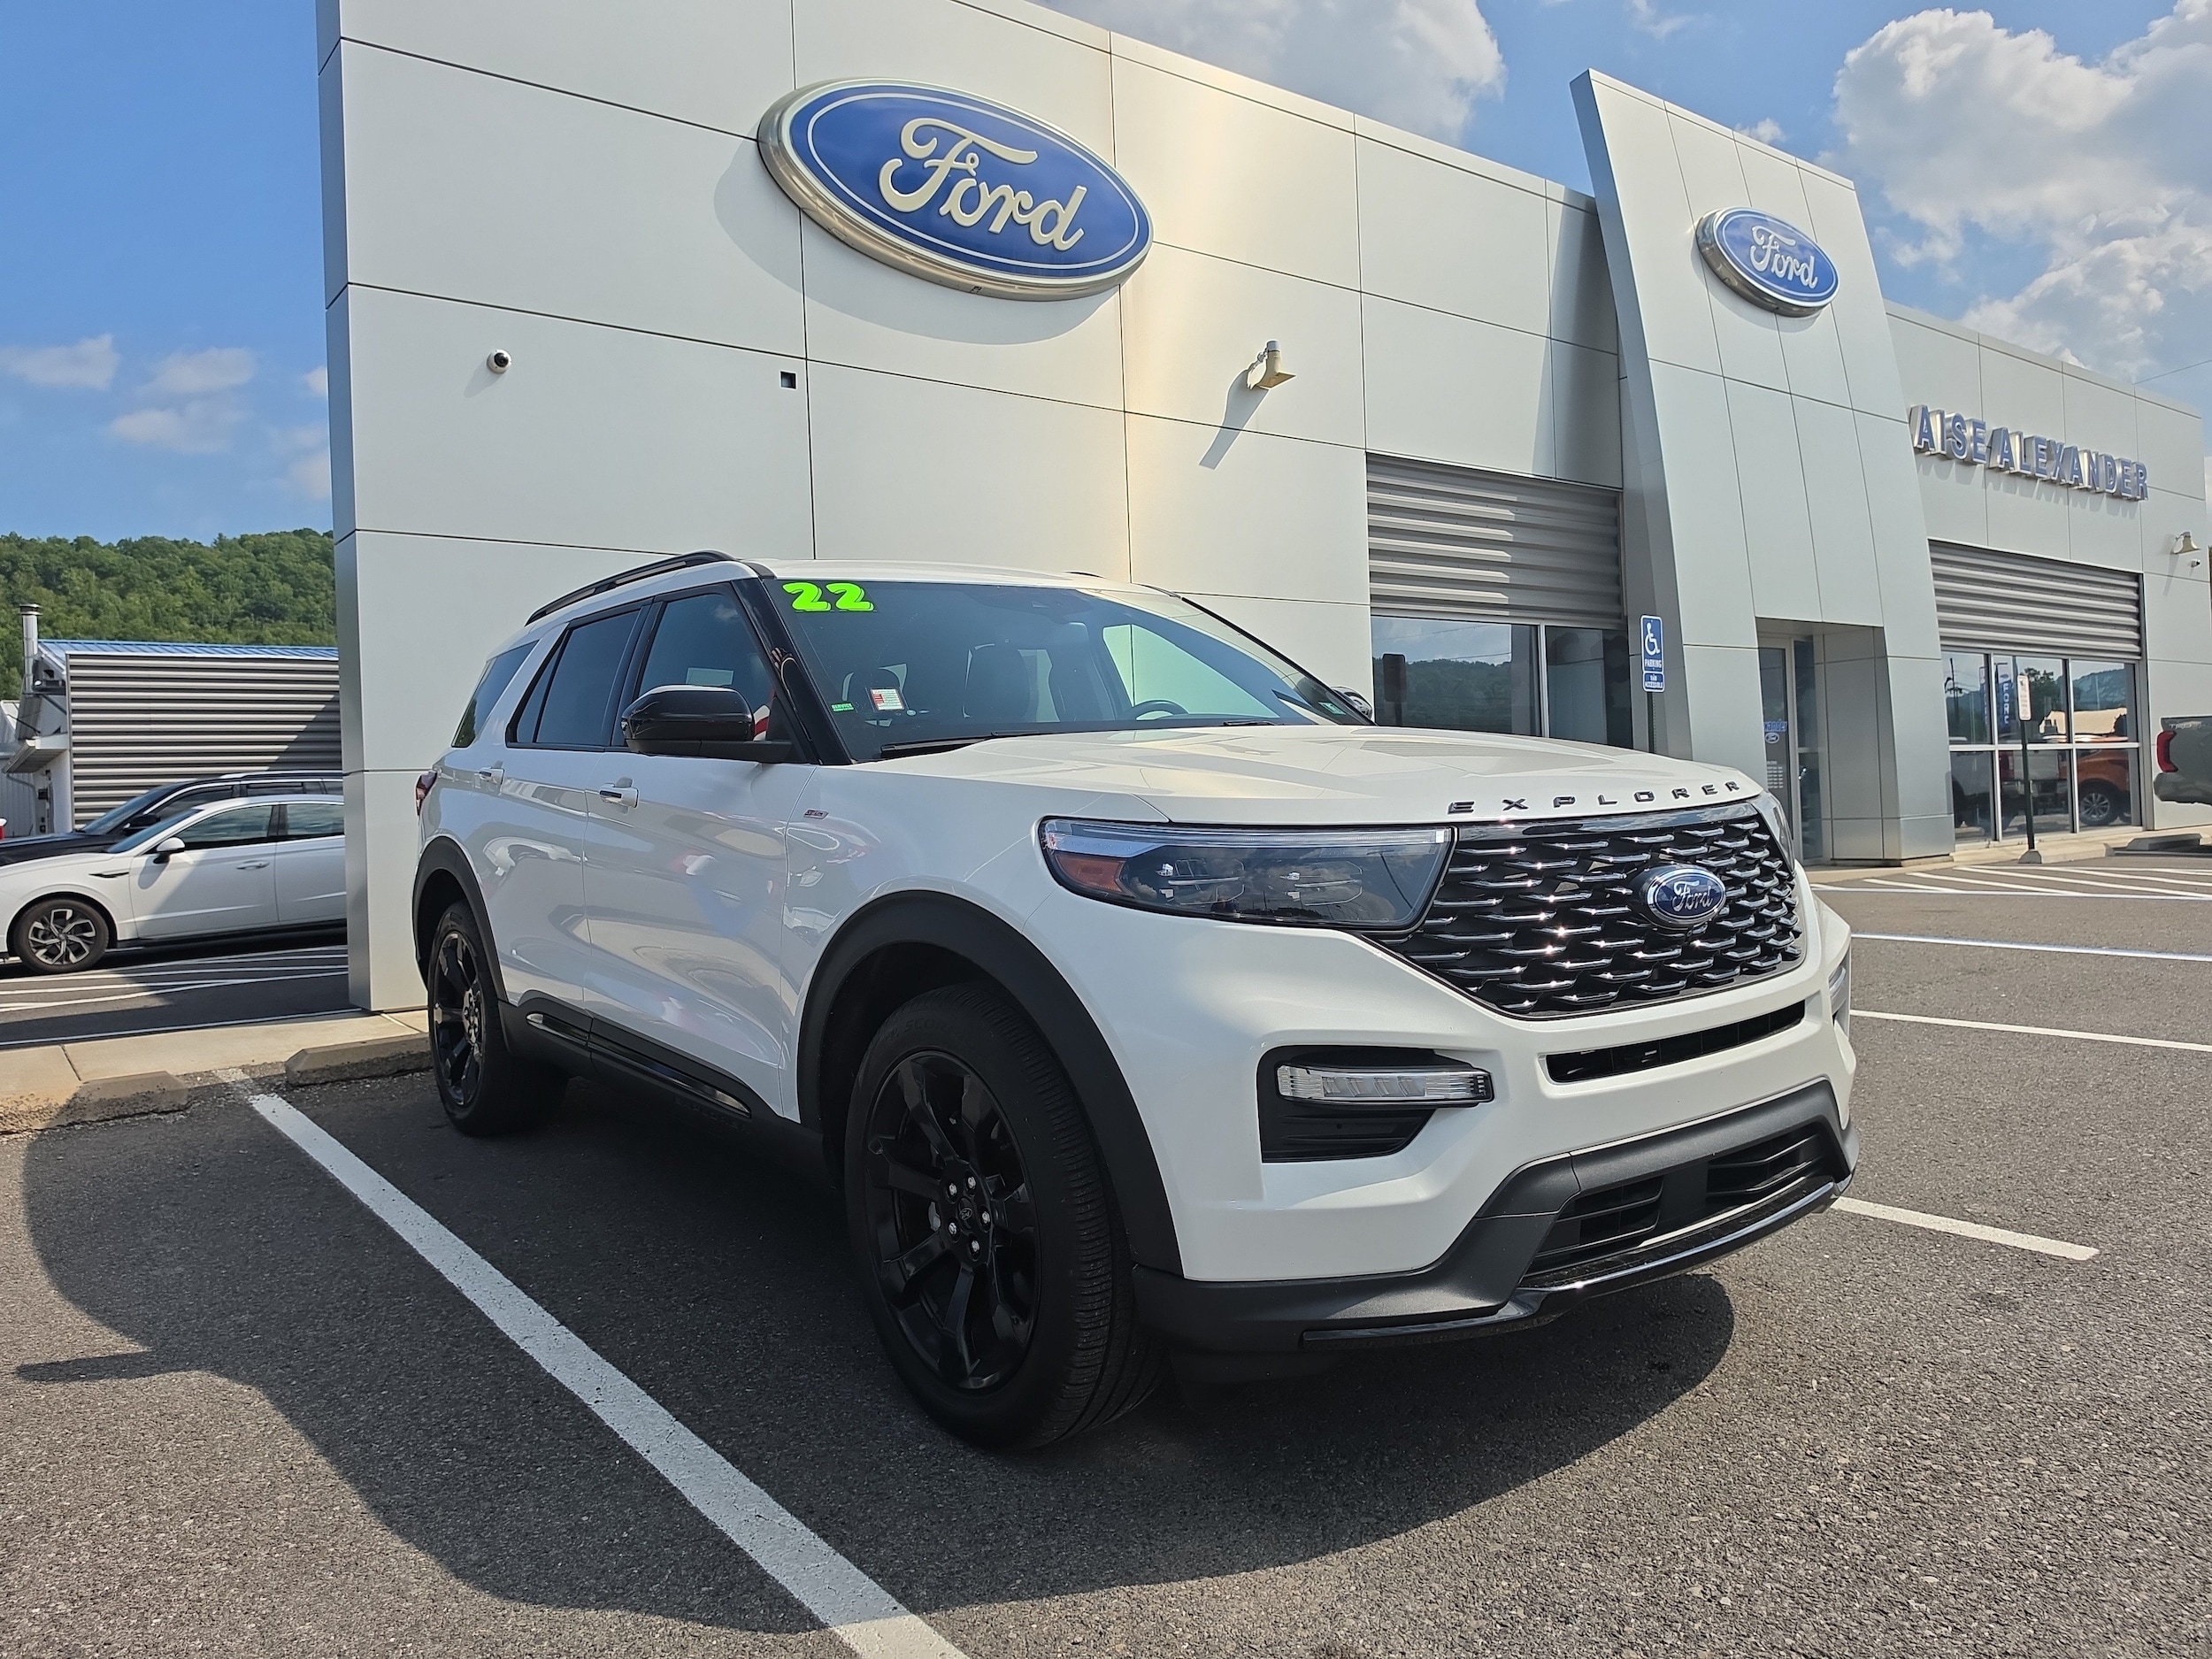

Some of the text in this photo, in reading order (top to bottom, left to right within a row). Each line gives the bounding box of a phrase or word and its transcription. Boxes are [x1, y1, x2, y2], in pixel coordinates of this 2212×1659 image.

[879, 117, 1088, 250] Ford
[1749, 226, 1818, 289] Ford
[1909, 403, 2149, 501] AISE ALEXANDER
[782, 581, 875, 612] 22
[1448, 780, 1740, 813] EXPLORER
[1671, 879, 1714, 912] Ford
